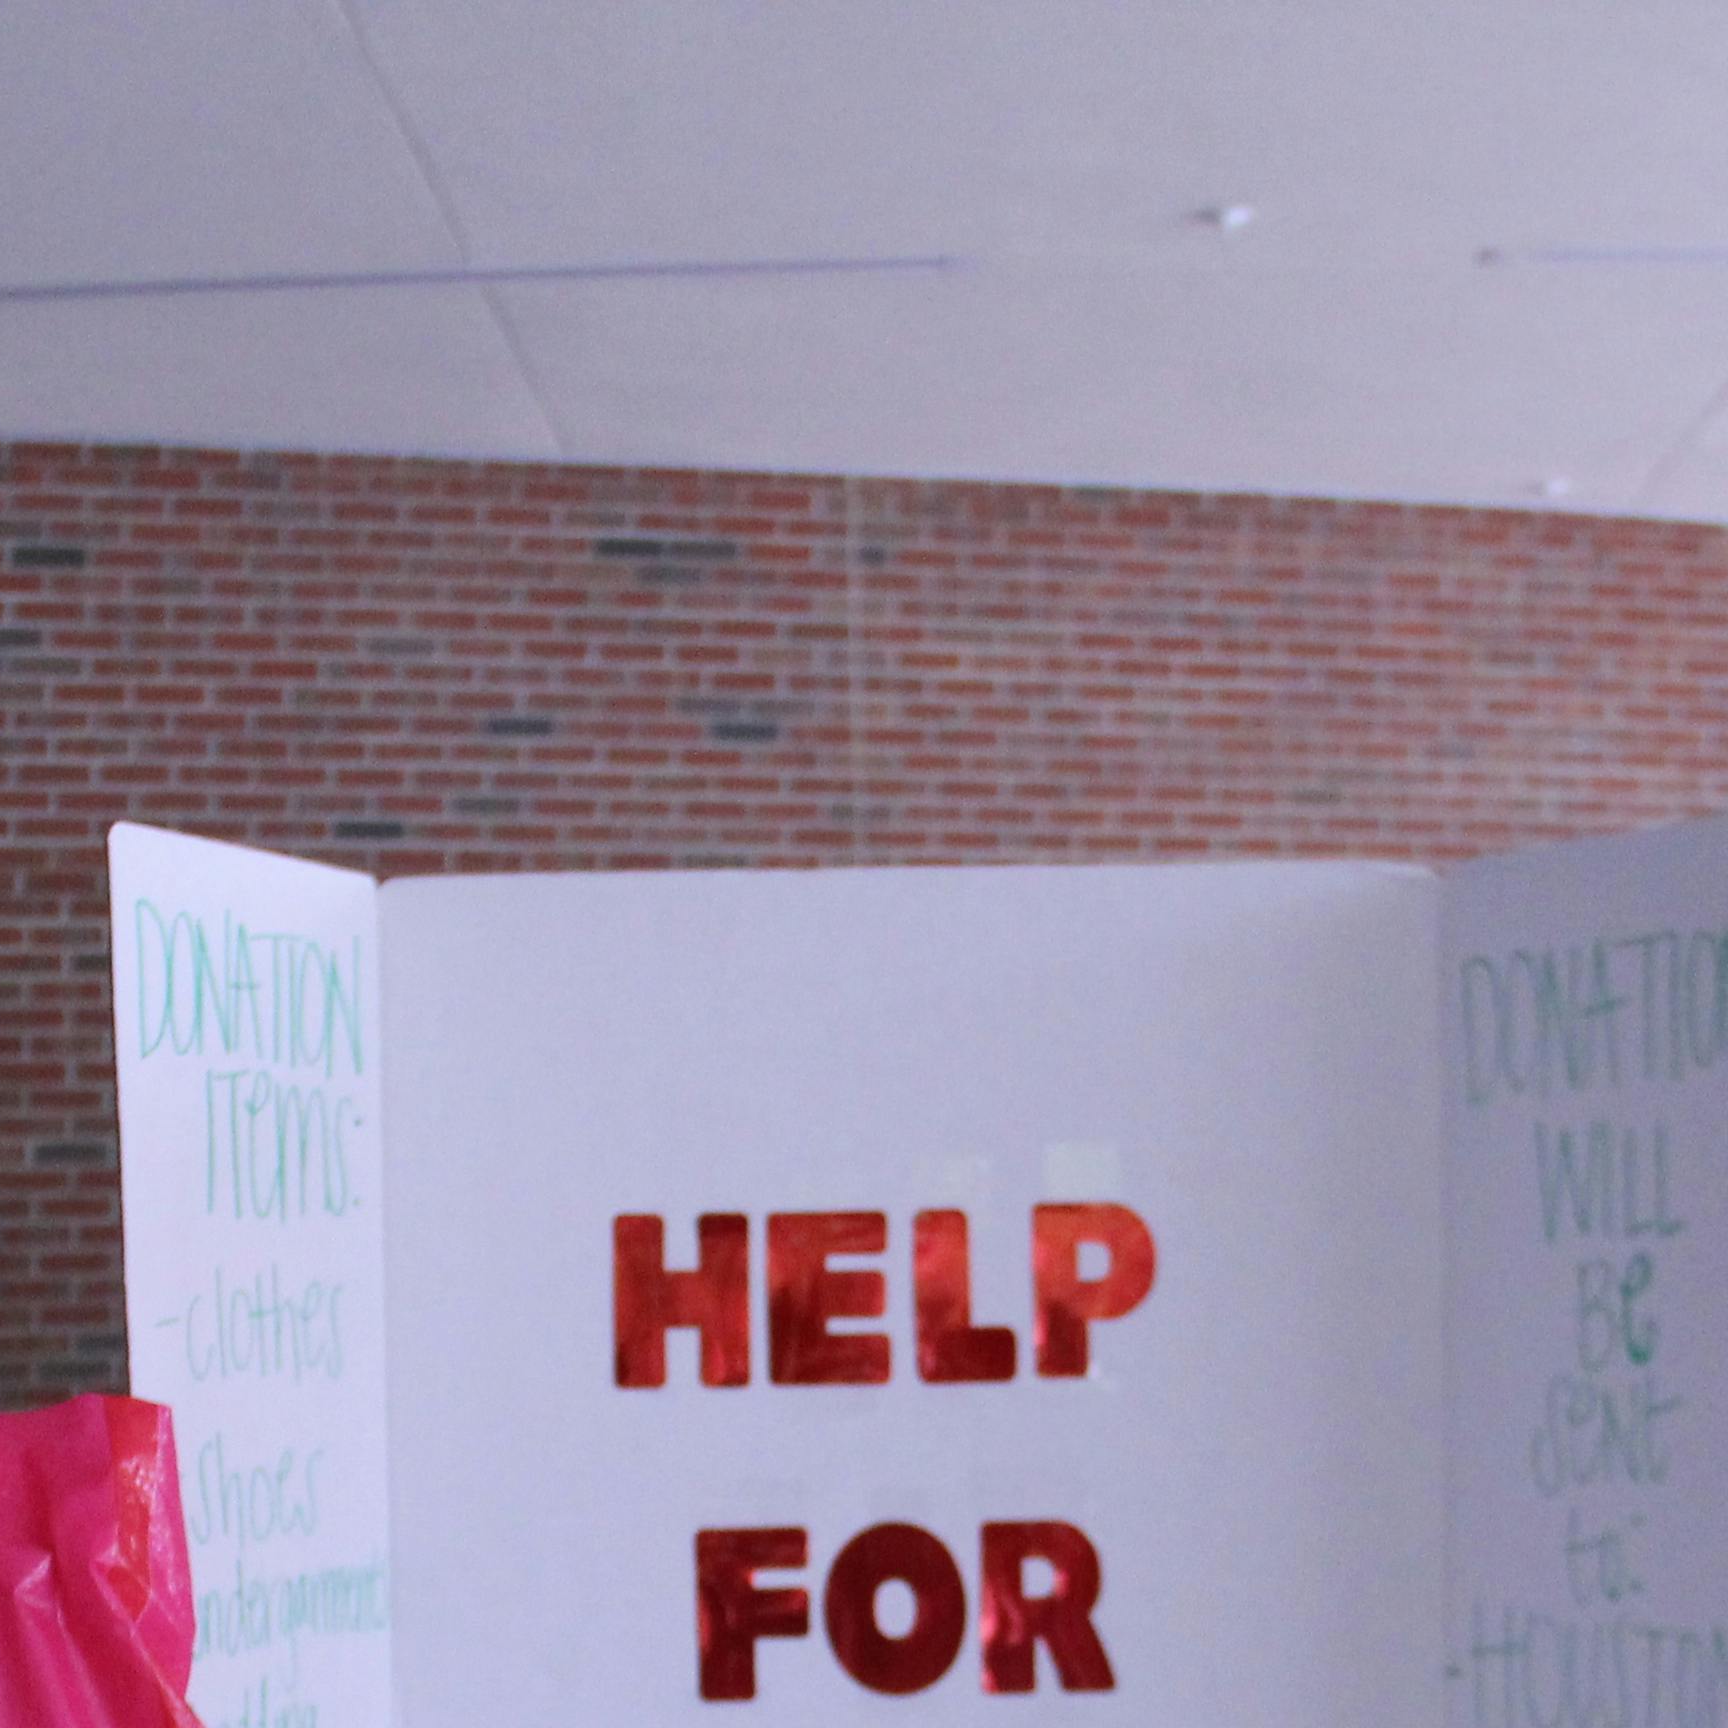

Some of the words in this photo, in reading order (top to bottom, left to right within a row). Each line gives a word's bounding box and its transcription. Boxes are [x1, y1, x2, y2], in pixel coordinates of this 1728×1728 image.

[135, 898, 363, 1076] DONATION
[1532, 1119, 1687, 1243] WILL
[612, 1203, 1156, 1388] HELP
[694, 1520, 1116, 1701] FOR
